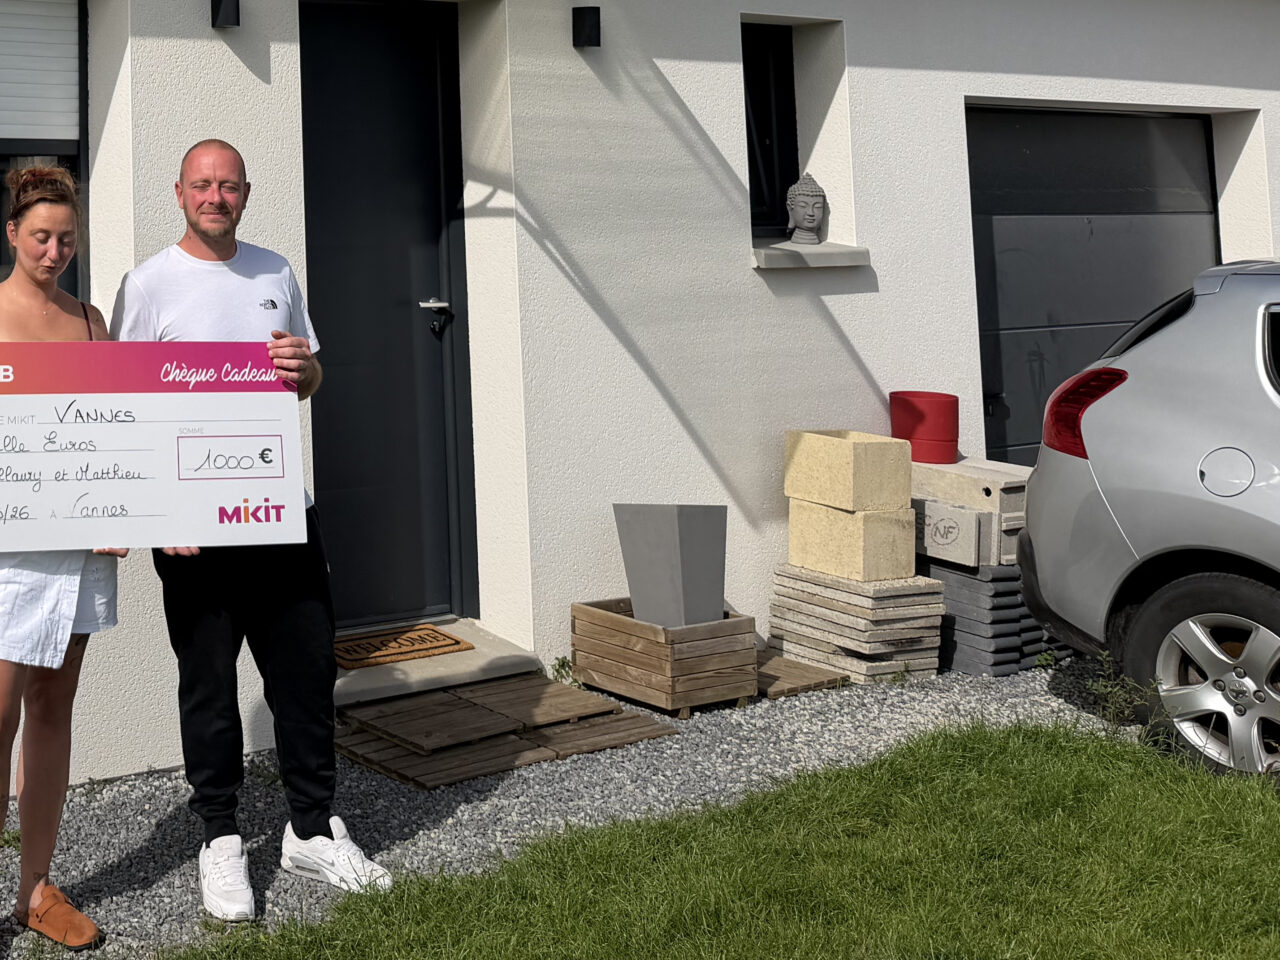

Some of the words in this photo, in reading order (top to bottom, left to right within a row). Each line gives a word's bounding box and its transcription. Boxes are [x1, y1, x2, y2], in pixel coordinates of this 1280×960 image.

[160, 360, 218, 390] Chèque
[221, 360, 278, 382] Cadeau
[7, 414, 36, 425] MIKIT
[54, 399, 136, 424] VANNES
[43, 430, 97, 453] Euros
[54, 468, 69, 481] et
[75, 461, 148, 482] Matthieu
[194, 447, 255, 472] 1000
[258, 447, 273, 464] €
[933, 525, 957, 540] NF
[339, 632, 447, 657] WELCOME
